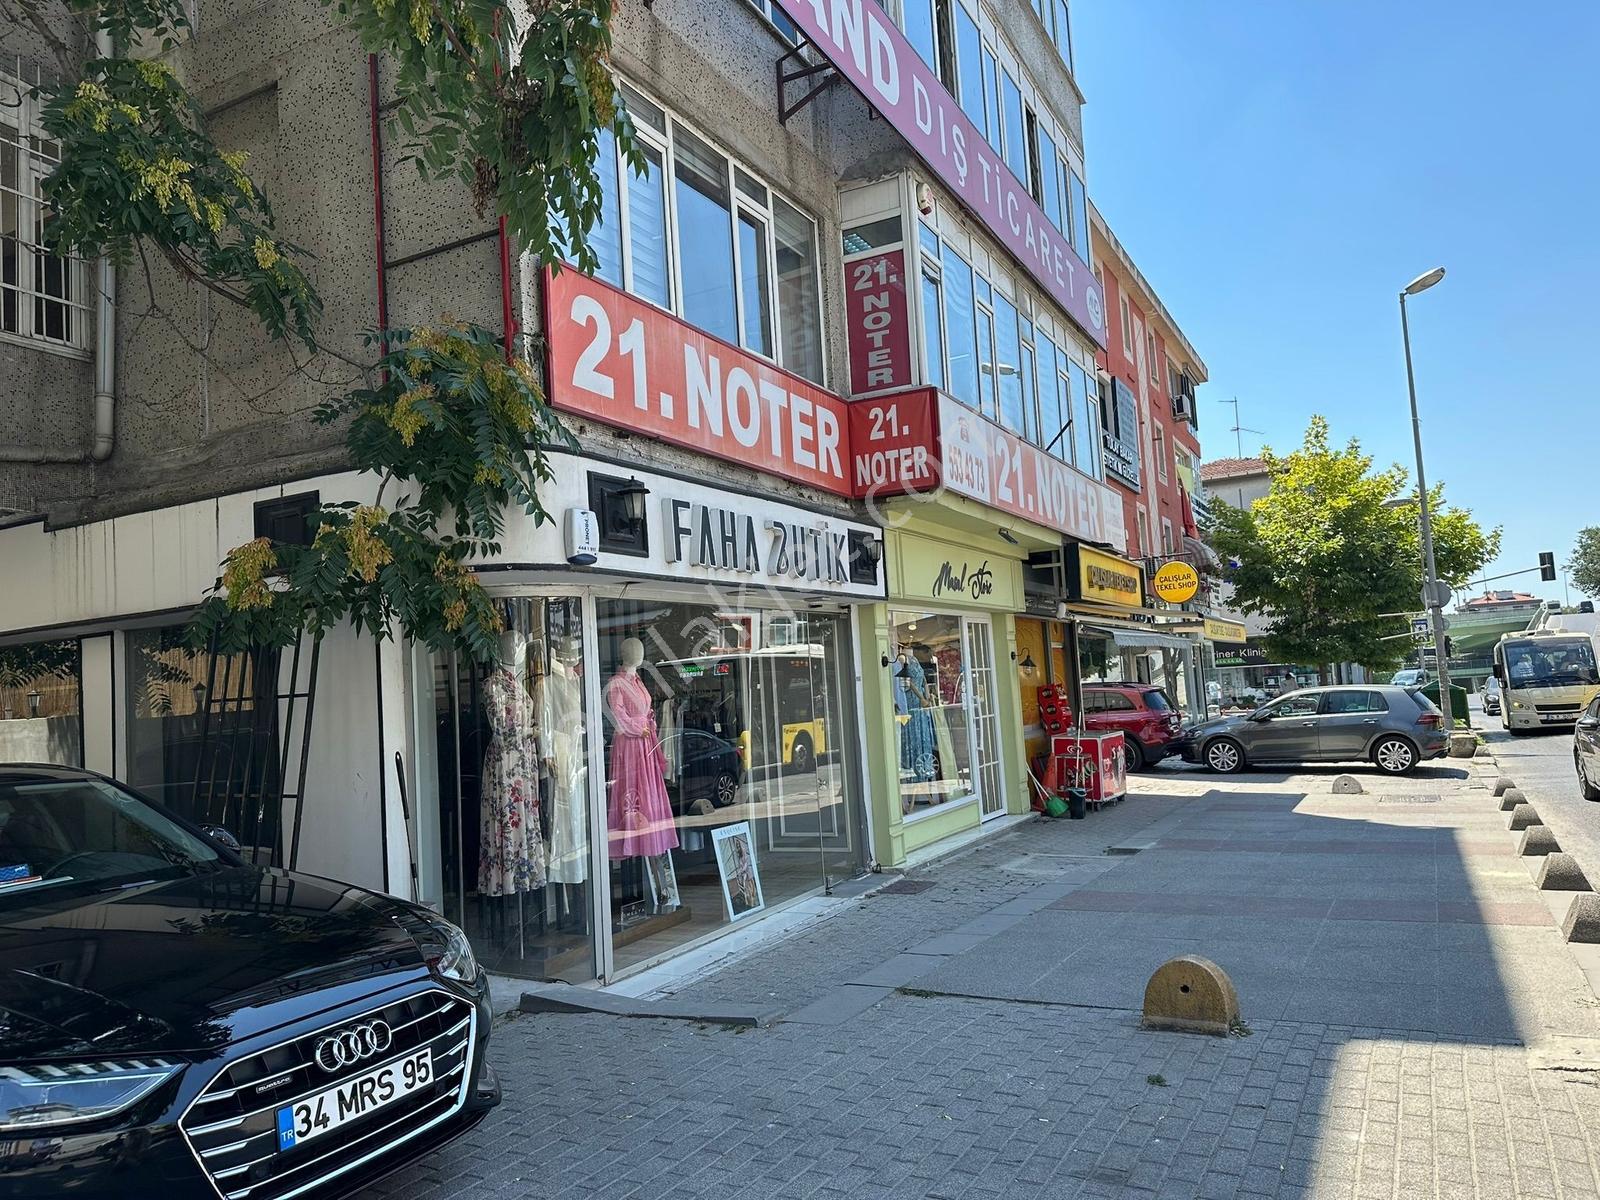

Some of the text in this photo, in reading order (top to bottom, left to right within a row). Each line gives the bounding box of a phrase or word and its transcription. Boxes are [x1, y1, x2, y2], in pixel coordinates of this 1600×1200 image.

[913, 74, 968, 187] DIŞ
[977, 152, 1075, 298] TİCARET
[853, 259, 897, 291] 21.
[863, 291, 894, 387] NOTER
[570, 294, 844, 479] 21. NOTER
[869, 404, 909, 441] 21.
[856, 445, 930, 487] NOTER
[994, 435, 1034, 513] 21.
[1034, 453, 1099, 544] NOTER
[661, 498, 760, 575] FAHA
[1155, 581, 1197, 592] TEKEL SHOP
[1159, 573, 1192, 583] ÇALIŞLAR
[281, 1051, 430, 1142] TR 34 MRS 95
